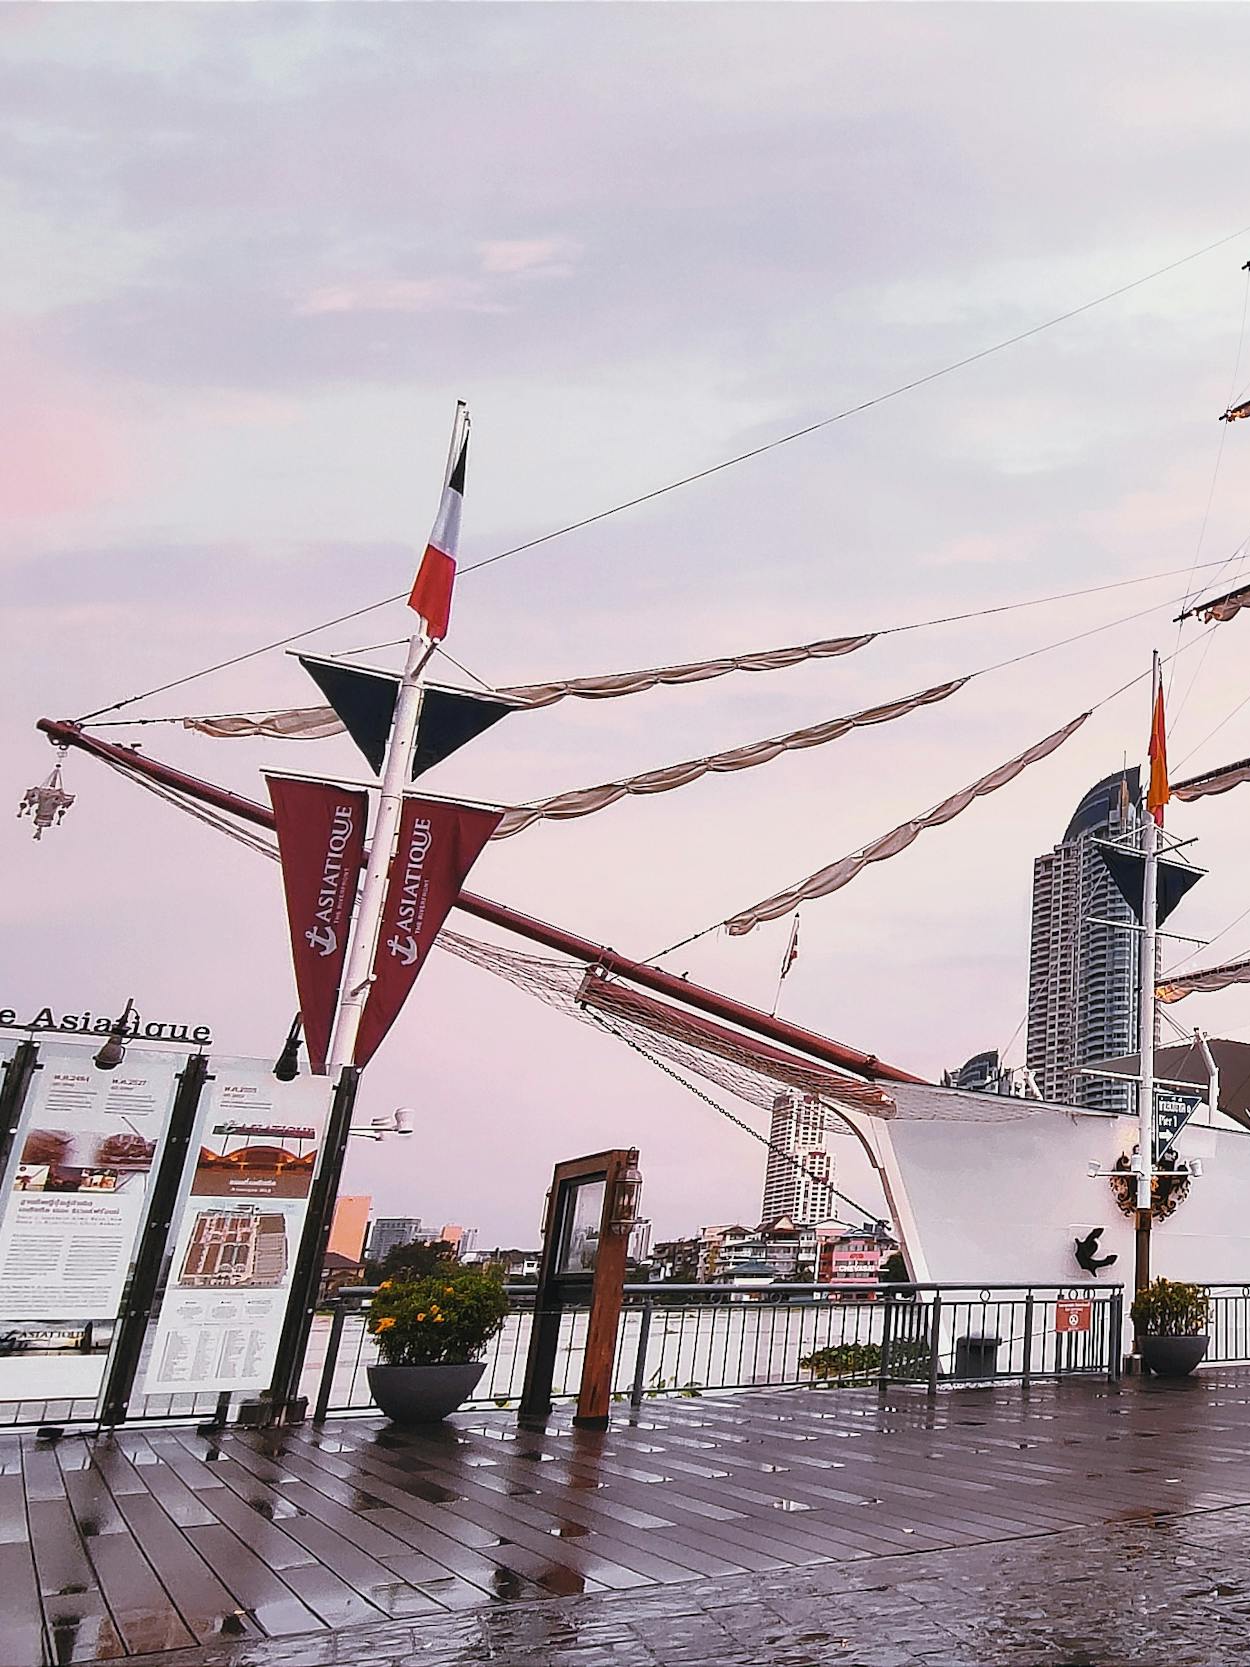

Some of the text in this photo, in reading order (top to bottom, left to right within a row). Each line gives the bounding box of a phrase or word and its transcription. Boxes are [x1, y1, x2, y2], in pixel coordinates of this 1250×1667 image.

[315, 805, 354, 923] ASIATIQUE
[396, 817, 433, 934] ASIATIQUE
[1158, 1114, 1173, 1126] Pier
